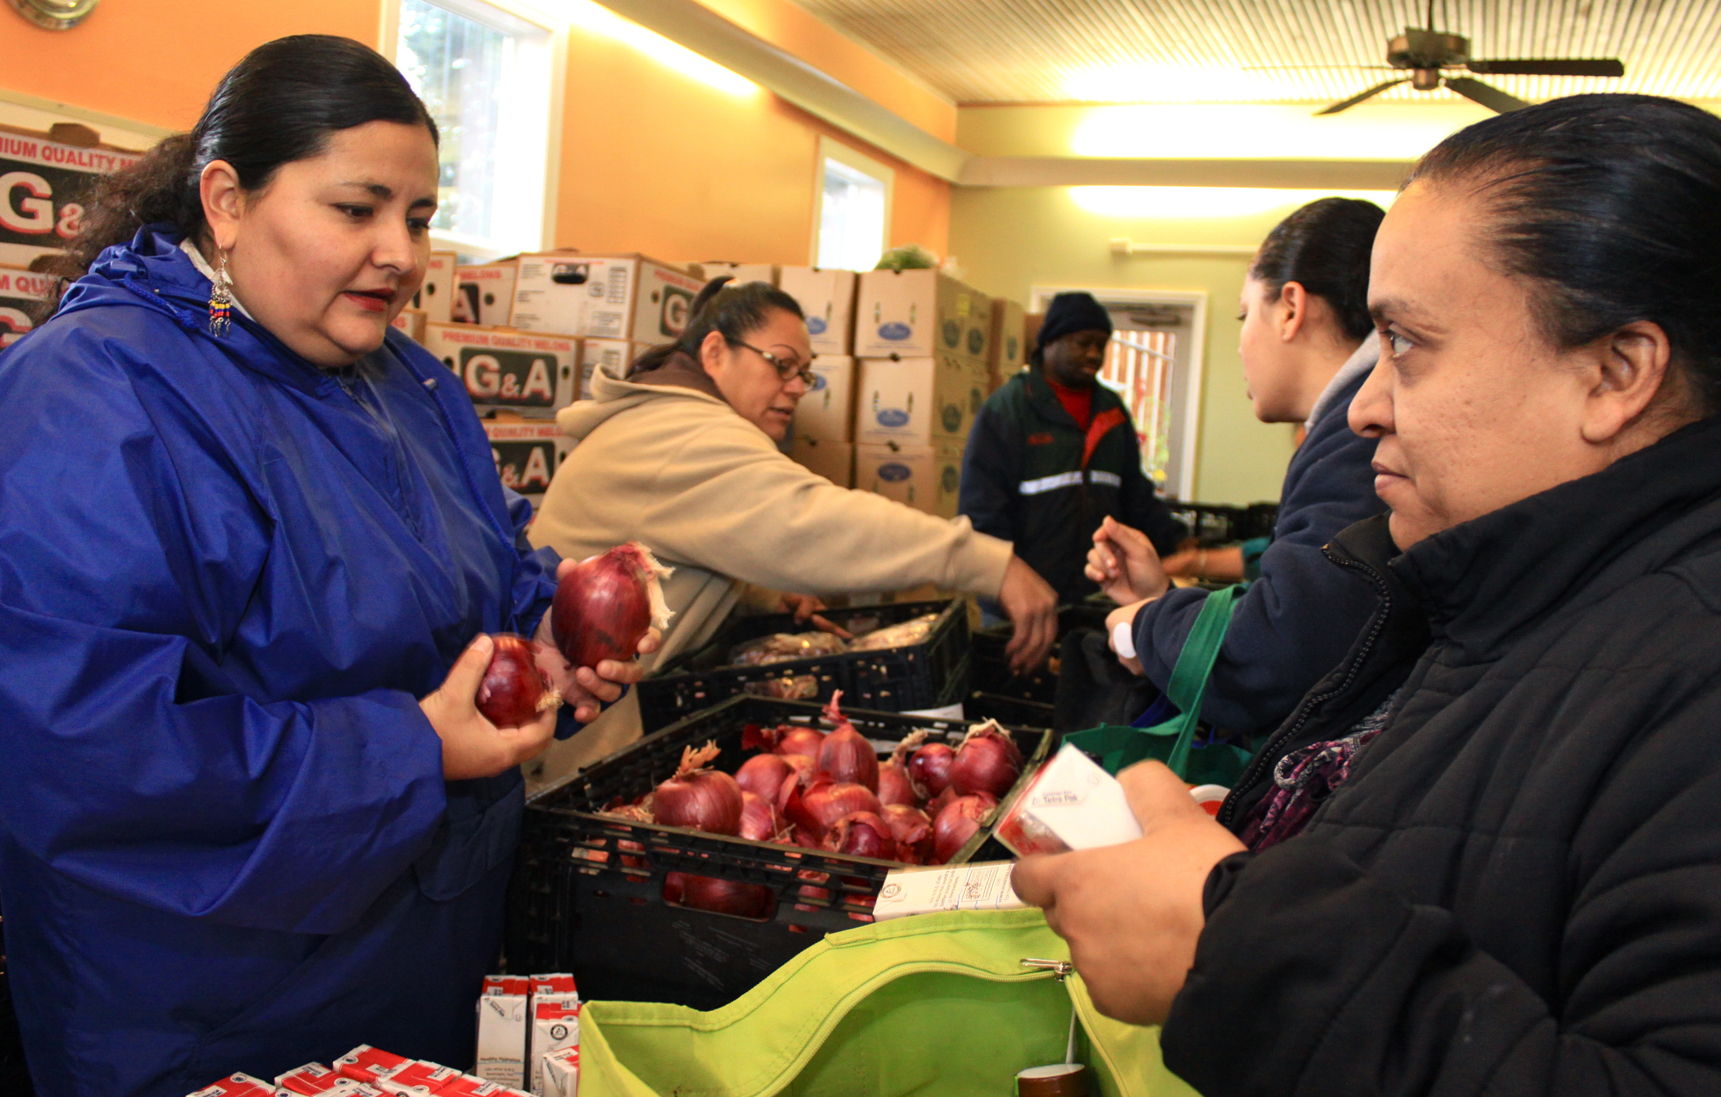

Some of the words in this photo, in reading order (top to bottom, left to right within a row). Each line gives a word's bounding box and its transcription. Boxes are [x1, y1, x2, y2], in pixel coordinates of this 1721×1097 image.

[0, 137, 38, 159] IUM
[41, 144, 118, 172] QUALITY
[442, 330, 490, 346] PREMIUM
[490, 334, 533, 350] QUALITY
[534, 339, 571, 352] MELONS
